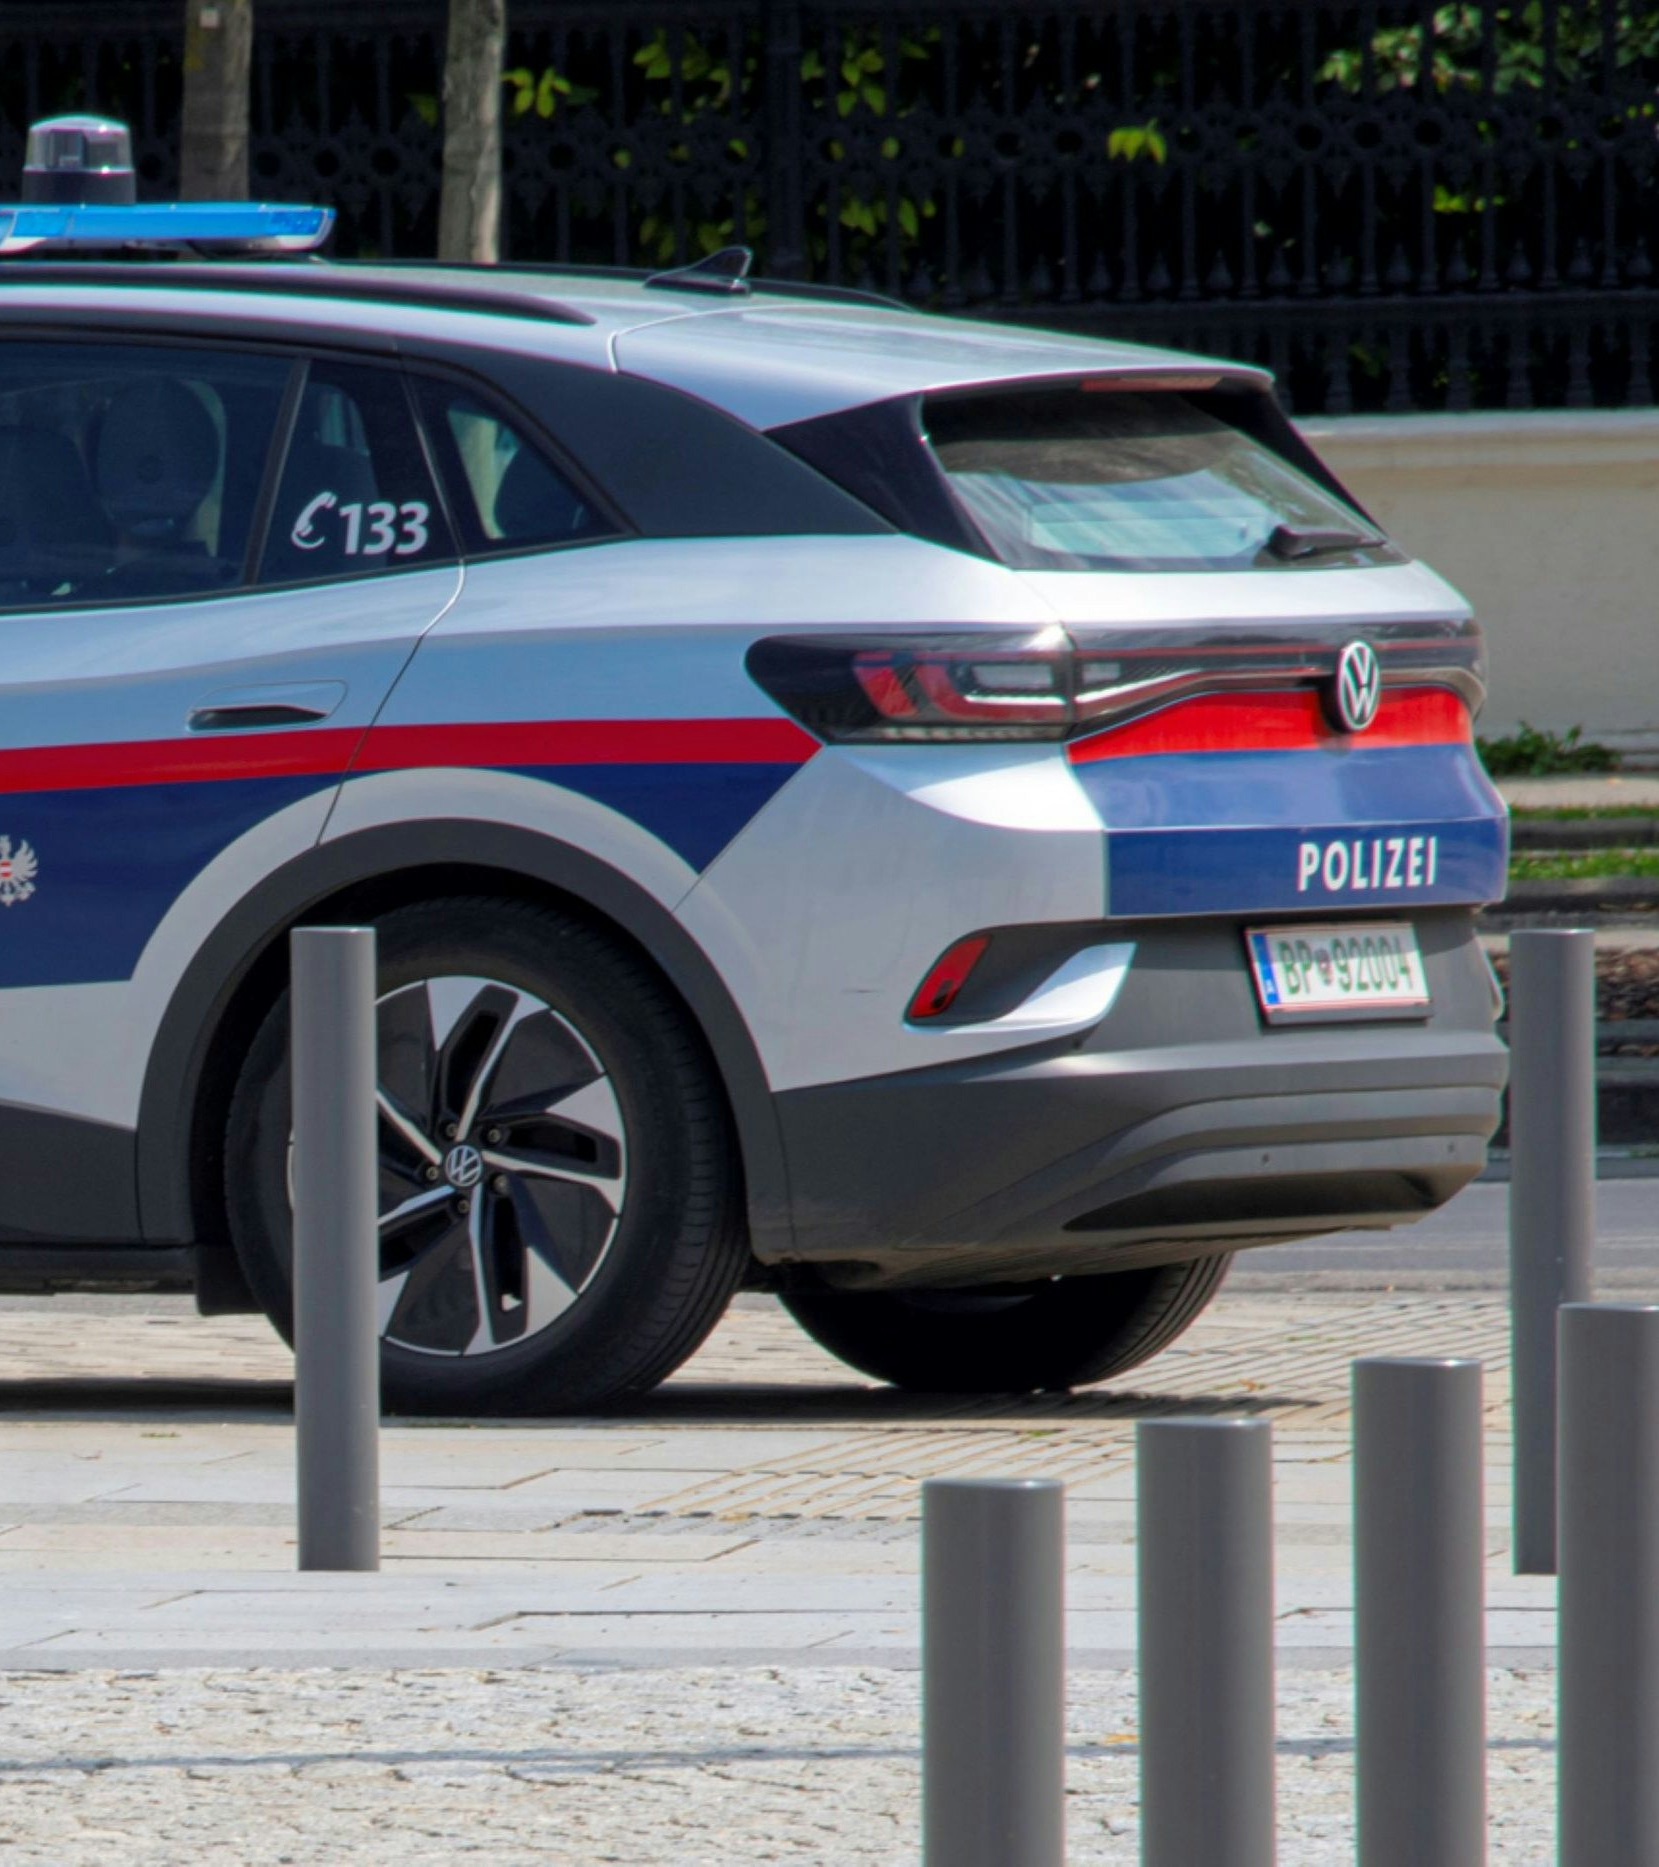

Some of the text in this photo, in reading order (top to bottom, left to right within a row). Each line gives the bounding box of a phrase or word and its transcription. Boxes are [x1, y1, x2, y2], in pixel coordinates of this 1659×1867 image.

[339, 502, 429, 555] 133
[1298, 835, 1438, 892] POLIZEI
[1278, 939, 1313, 995] BP
